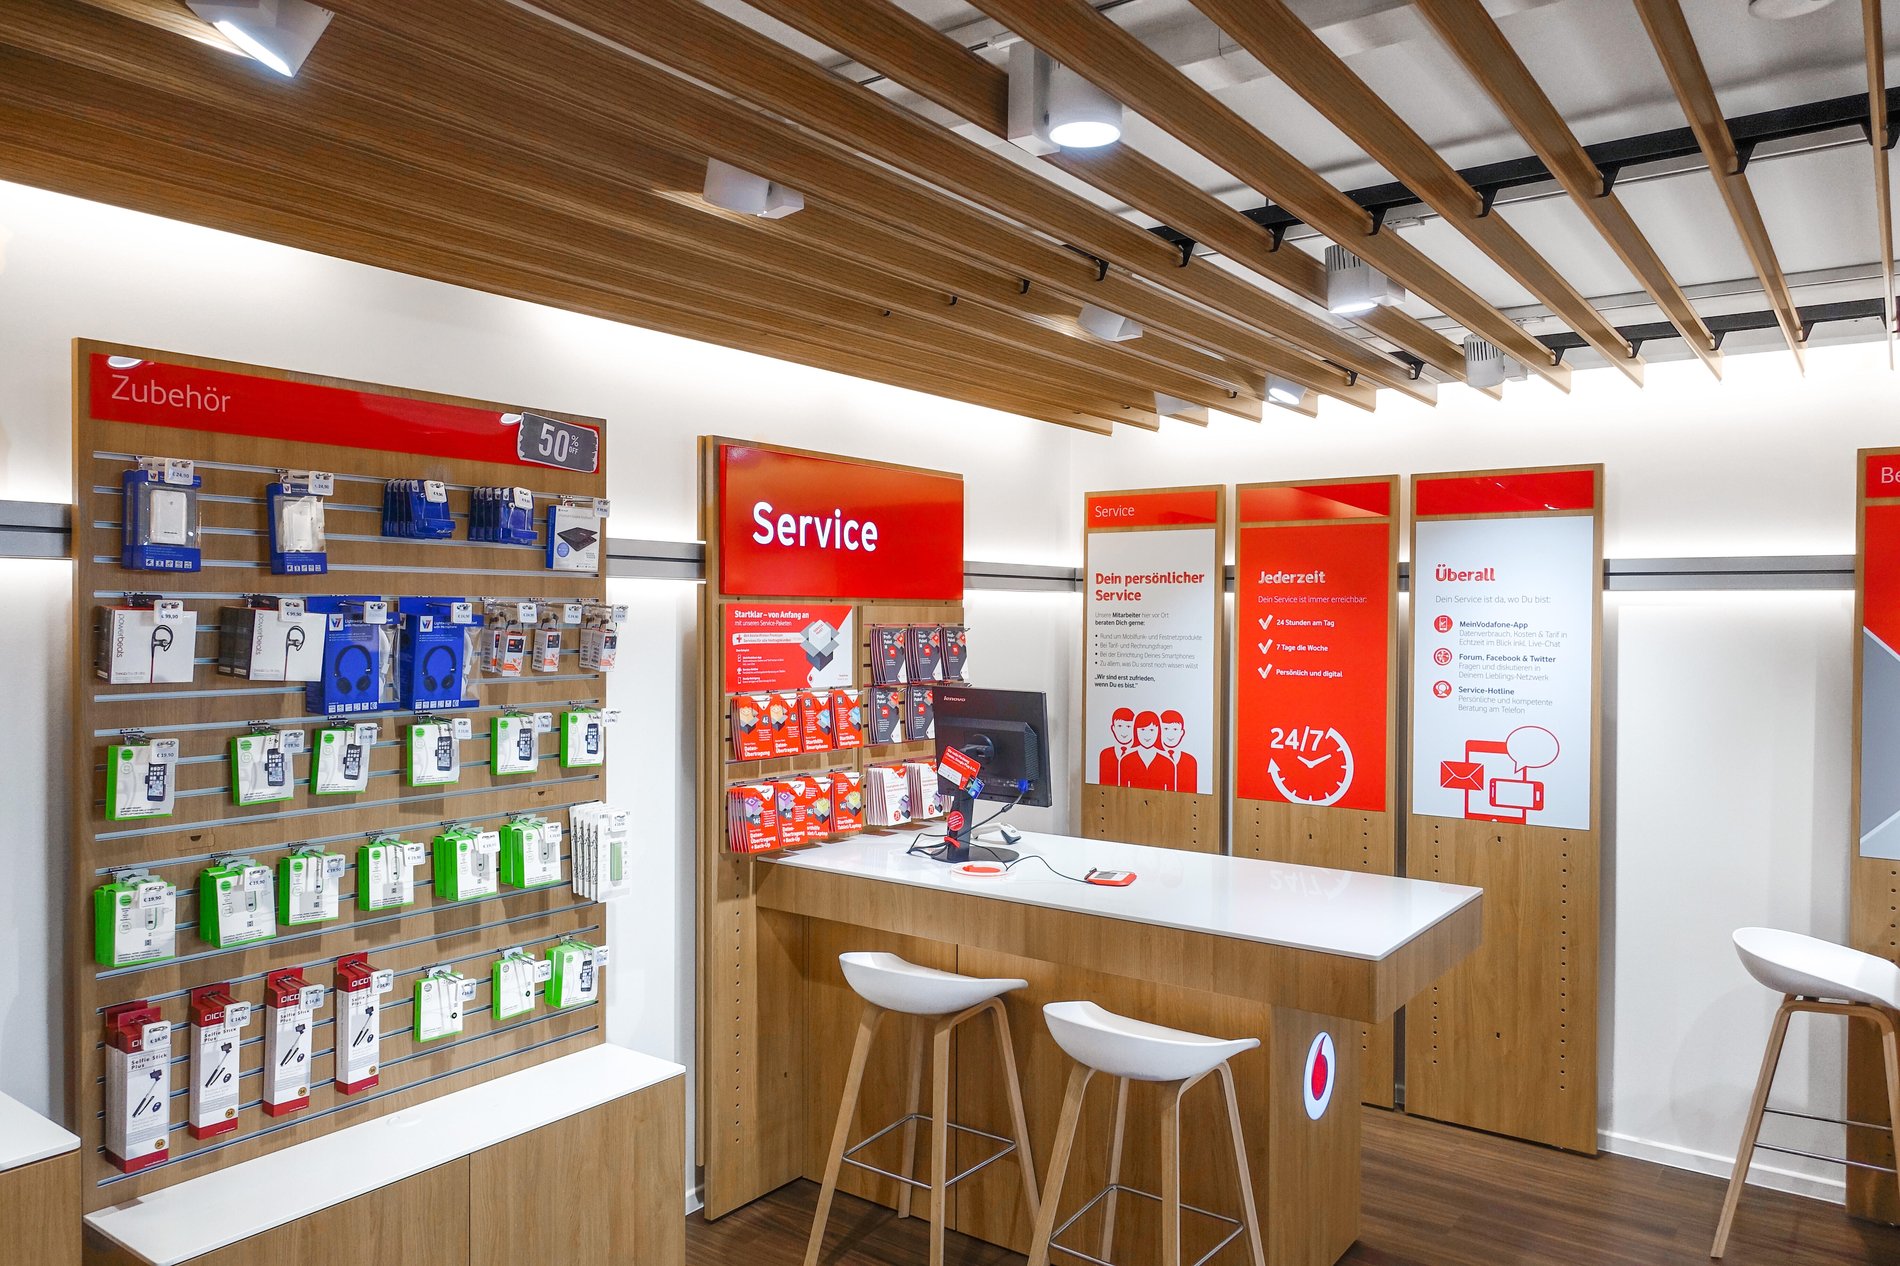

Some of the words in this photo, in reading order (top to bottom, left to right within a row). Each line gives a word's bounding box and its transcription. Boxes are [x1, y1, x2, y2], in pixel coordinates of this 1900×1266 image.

[112, 374, 231, 412] Zubehör
[538, 423, 578, 462] 50%
[569, 446, 578, 455] OFF
[1095, 505, 1135, 518] Service
[752, 502, 878, 552] Service
[1095, 573, 1121, 584] Dein
[1125, 571, 1204, 586] persönlicher
[1258, 570, 1325, 584] Jederzeit
[1435, 564, 1495, 582] Überall
[1096, 589, 1141, 601] Service
[780, 612, 801, 620] Anfang
[331, 618, 342, 628] V7
[421, 619, 431, 628] V7
[1459, 662, 1481, 670] Fragen
[1486, 672, 1549, 681] Lieblings-Netzwerk
[1458, 686, 1514, 695] Service-Hotline
[1459, 695, 1496, 703] Persönliche
[1512, 697, 1553, 706] kompetente
[1458, 704, 1487, 713] Beratung
[1501, 706, 1525, 714] Telefon
[1270, 726, 1324, 752] 24/7
[751, 836, 775, 844] Übertragung
